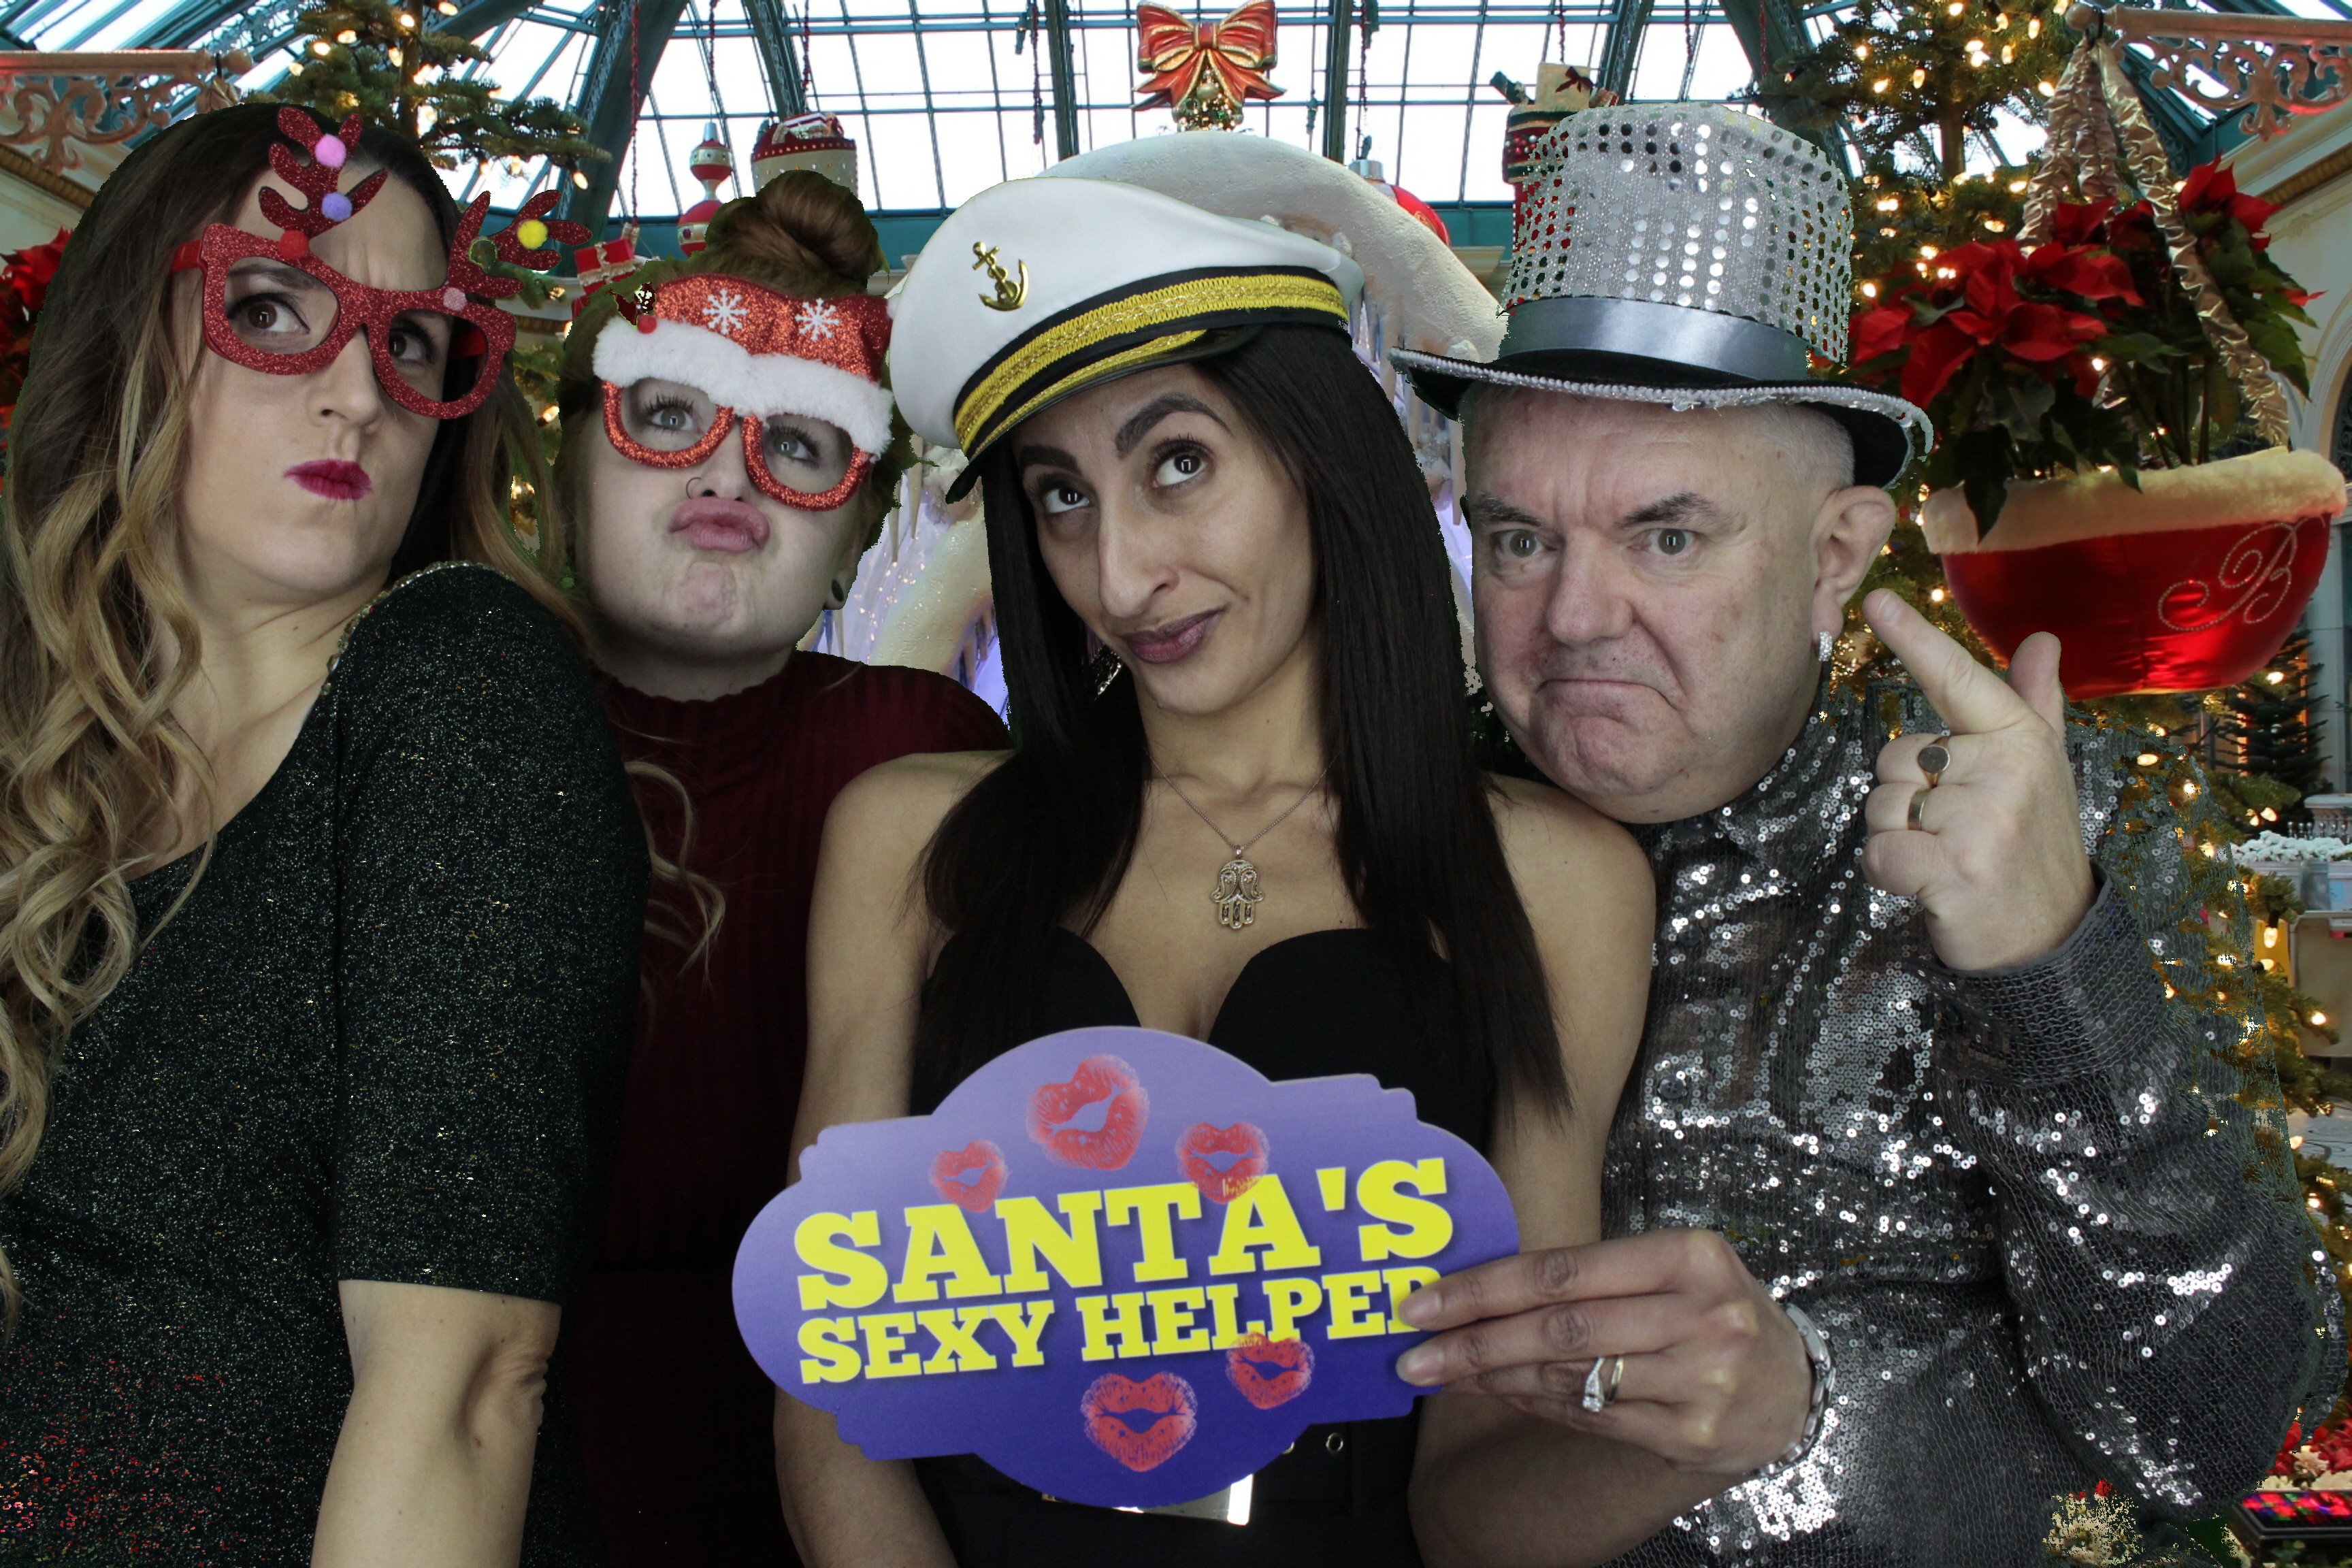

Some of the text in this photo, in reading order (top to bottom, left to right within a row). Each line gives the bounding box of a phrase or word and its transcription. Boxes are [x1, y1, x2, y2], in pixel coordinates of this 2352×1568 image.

[2158, 515, 2326, 632] B
[794, 1158, 1454, 1310] SANTA'S
[798, 1301, 1055, 1383] SEXY
